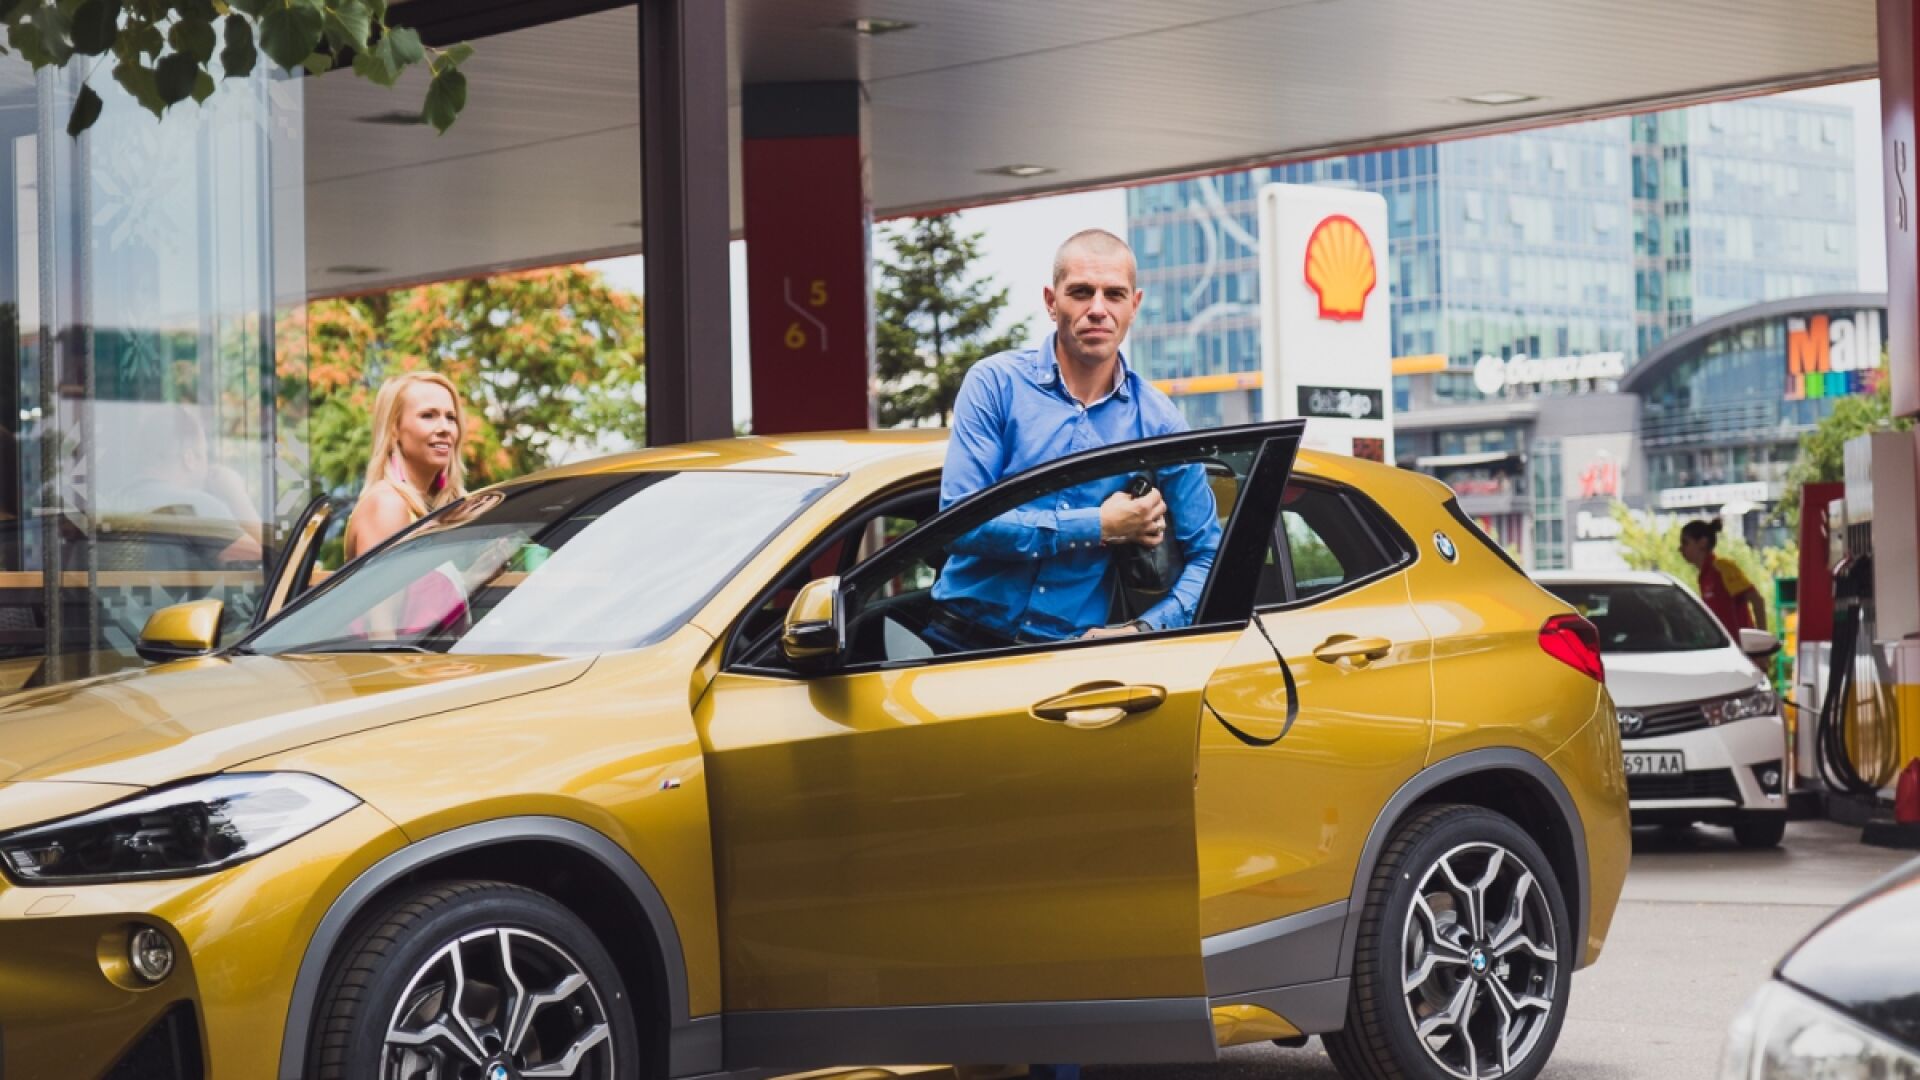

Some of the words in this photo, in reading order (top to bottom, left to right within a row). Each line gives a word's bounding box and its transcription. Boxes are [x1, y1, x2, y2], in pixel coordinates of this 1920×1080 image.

[809, 280, 827, 307] 5
[784, 322, 807, 350] 6
[1658, 755, 1679, 773] AA
